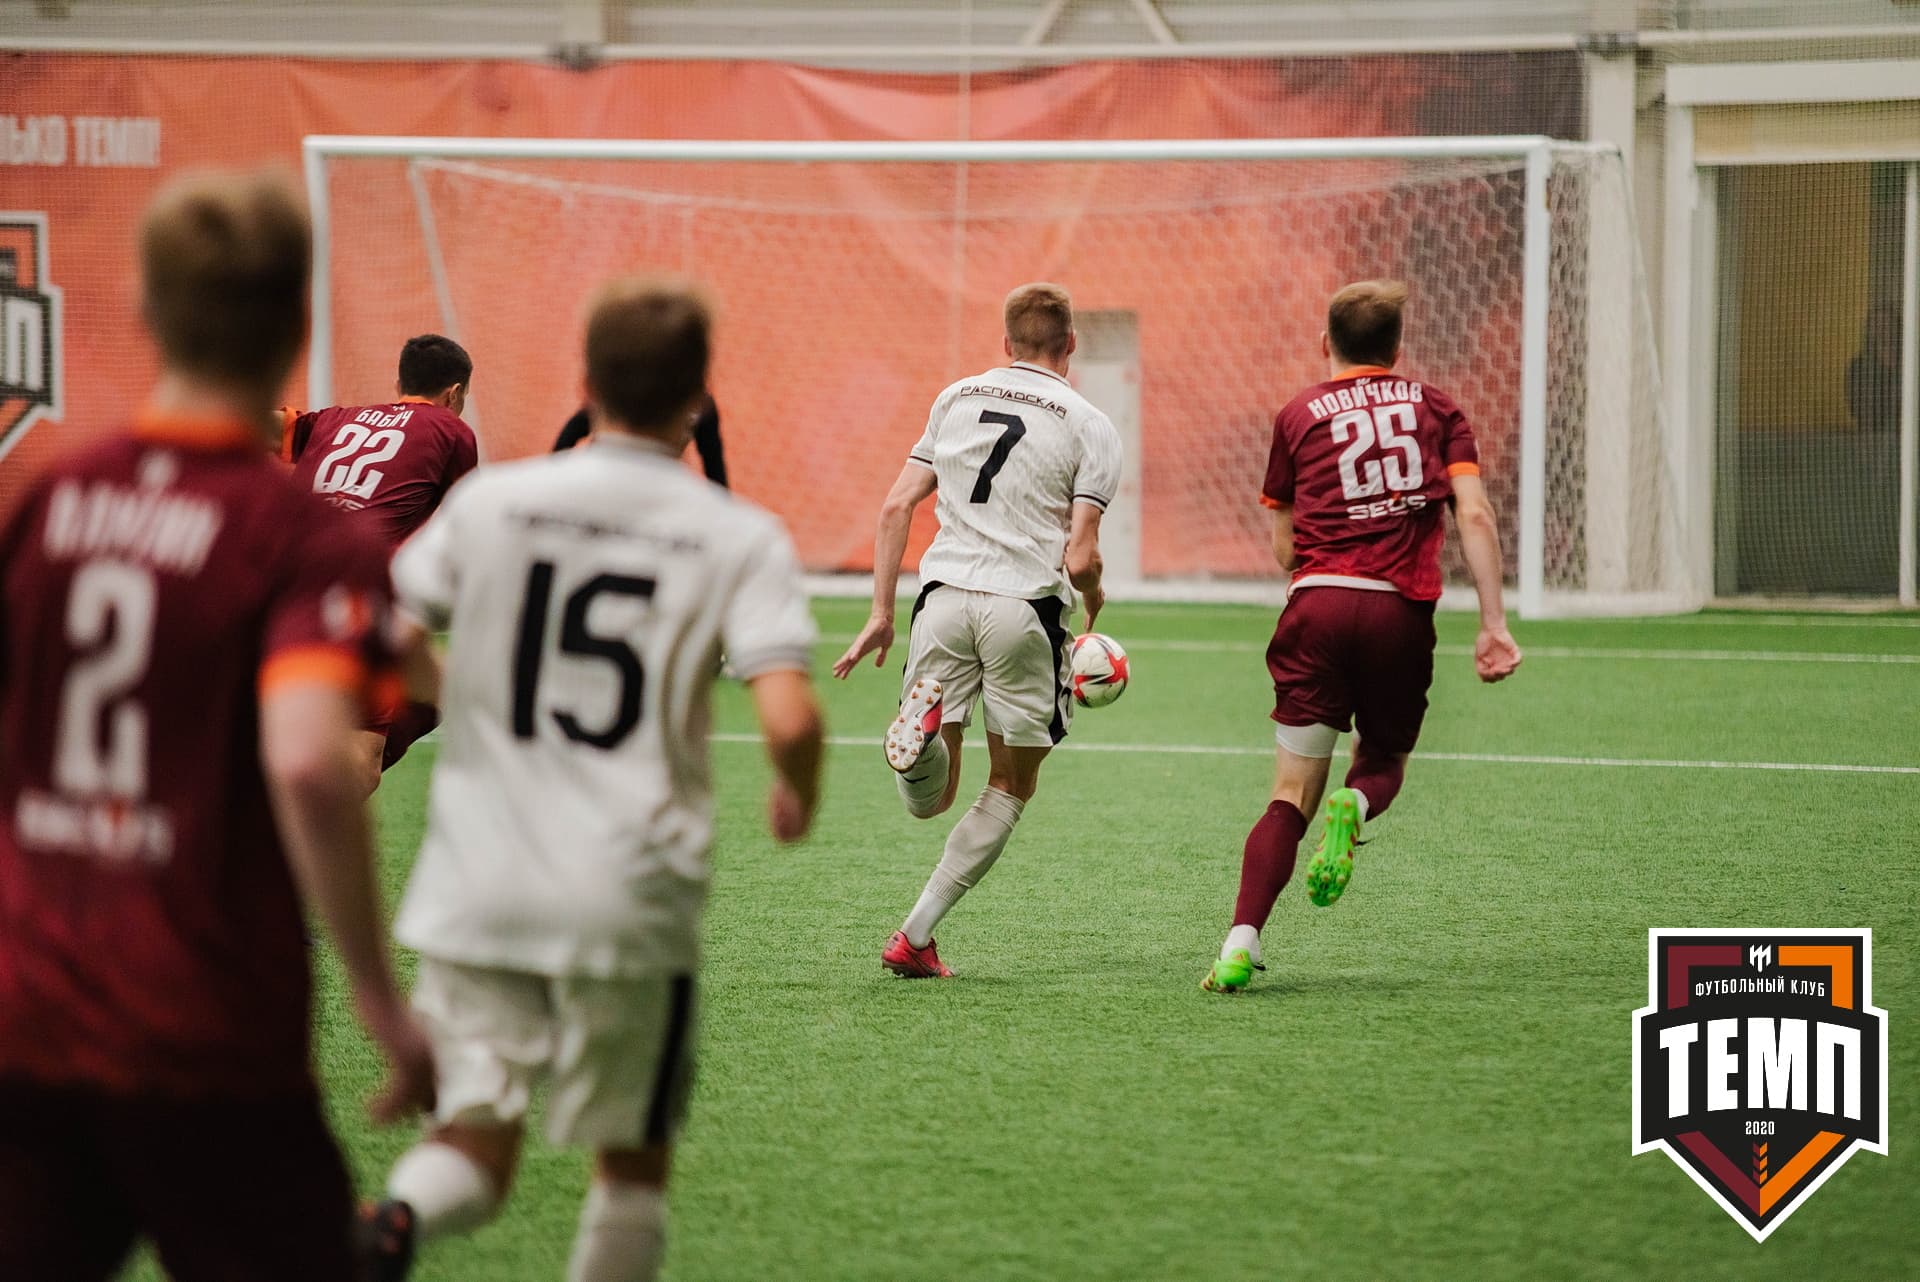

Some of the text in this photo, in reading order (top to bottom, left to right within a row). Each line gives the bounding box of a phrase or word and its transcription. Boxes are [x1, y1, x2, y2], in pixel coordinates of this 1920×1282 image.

[1307, 379, 1423, 419] НОВИЧКОВ
[313, 423, 405, 500] 22
[969, 409, 1027, 504] 7
[1331, 403, 1424, 500] 25
[54, 558, 158, 799] 2
[511, 560, 657, 751] 15
